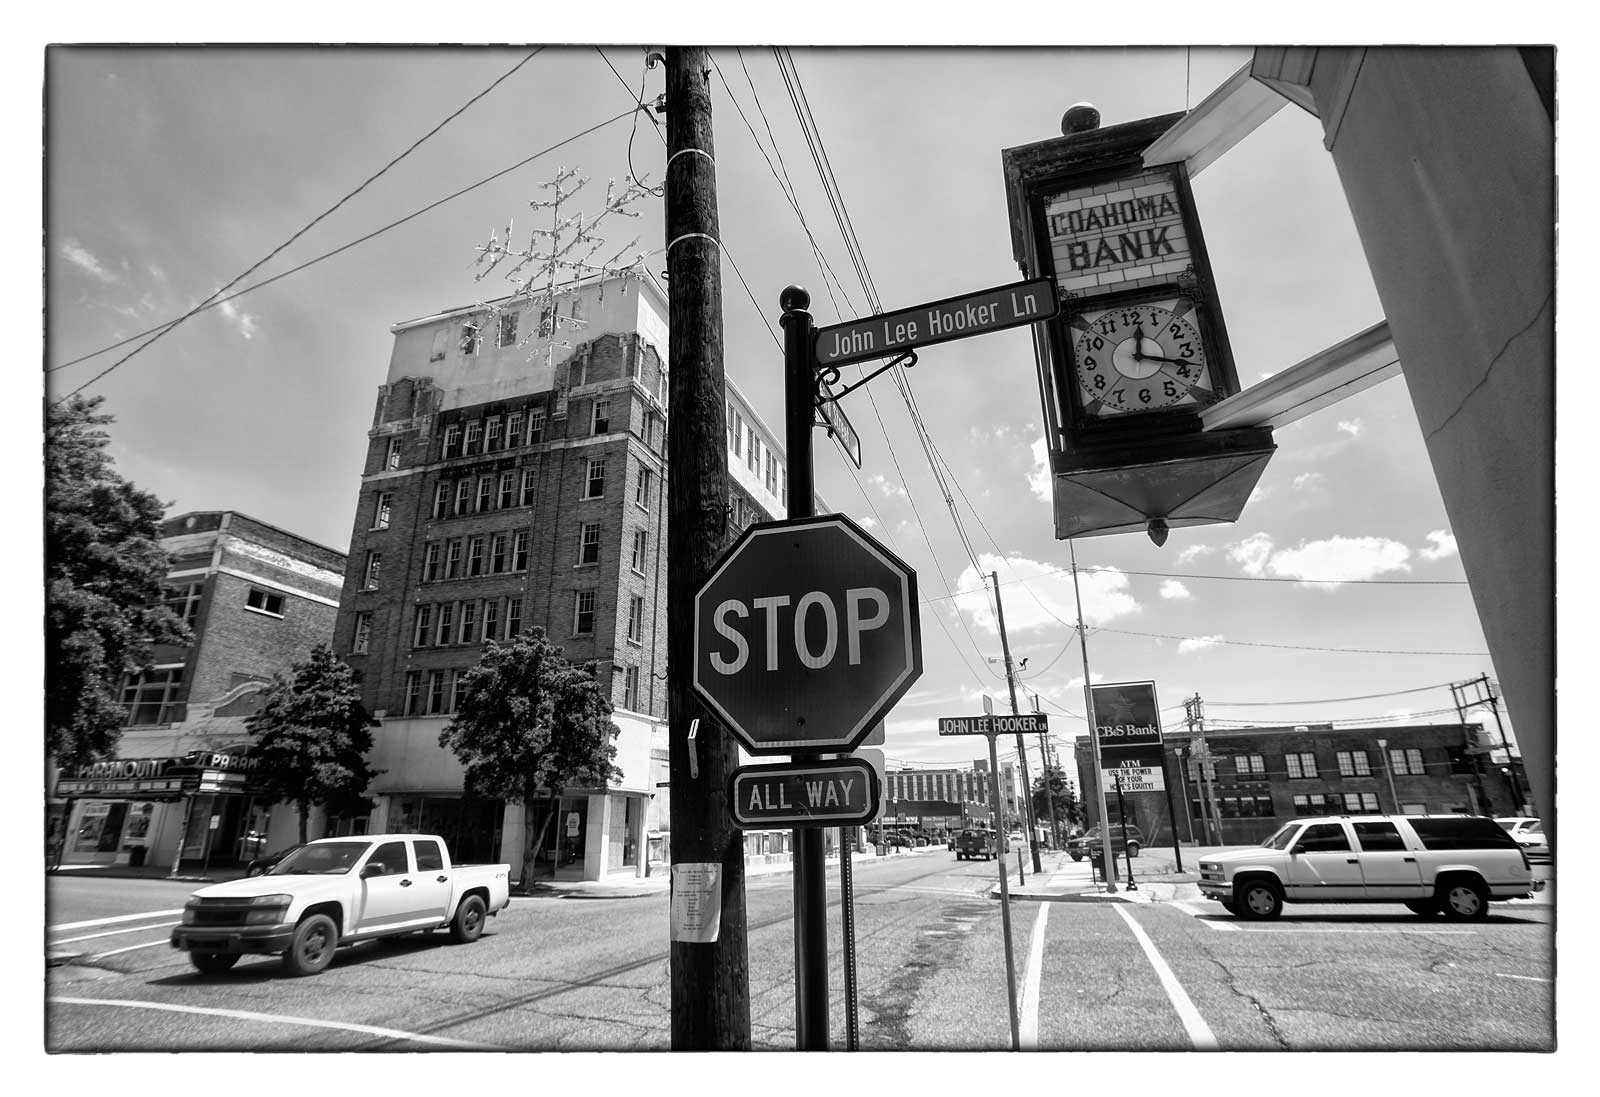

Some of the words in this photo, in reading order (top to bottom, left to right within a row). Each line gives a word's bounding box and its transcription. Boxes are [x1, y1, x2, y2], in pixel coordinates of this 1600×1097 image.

[1053, 194, 1180, 235] COAHOMA
[1068, 226, 1175, 270] BANK
[829, 329, 874, 358] John
[884, 320, 918, 346] Lee
[928, 302, 999, 336] Hooker
[1011, 292, 1037, 318] Ln
[1121, 311, 1144, 327] 12
[1149, 312, 1159, 327] 1
[1101, 319, 1117, 336] 11
[1169, 323, 1185, 340] 2
[1085, 336, 1104, 352] 10
[1179, 342, 1195, 358] 3
[1083, 355, 1097, 371] 9
[1176, 362, 1191, 378] 4
[1093, 374, 1106, 390] 8
[1163, 381, 1176, 397] 5
[1112, 389, 1125, 404] 7
[1138, 388, 1151, 404] 6
[710, 587, 890, 675] STOP
[940, 719, 969, 734] JOHN
[972, 718, 990, 733] LEE
[992, 717, 1038, 732] HOOKER
[1039, 722, 1048, 731] LN
[1097, 725, 1125, 738] CB&S
[1126, 723, 1158, 736] Bank
[211, 753, 264, 770] PARAM
[1120, 760, 1140, 768] ATM
[1108, 769, 1119, 777] USE
[1132, 768, 1152, 776] POWER
[1127, 775, 1143, 783] YOUR
[749, 782, 793, 811] ALL
[805, 778, 854, 808] WAY
